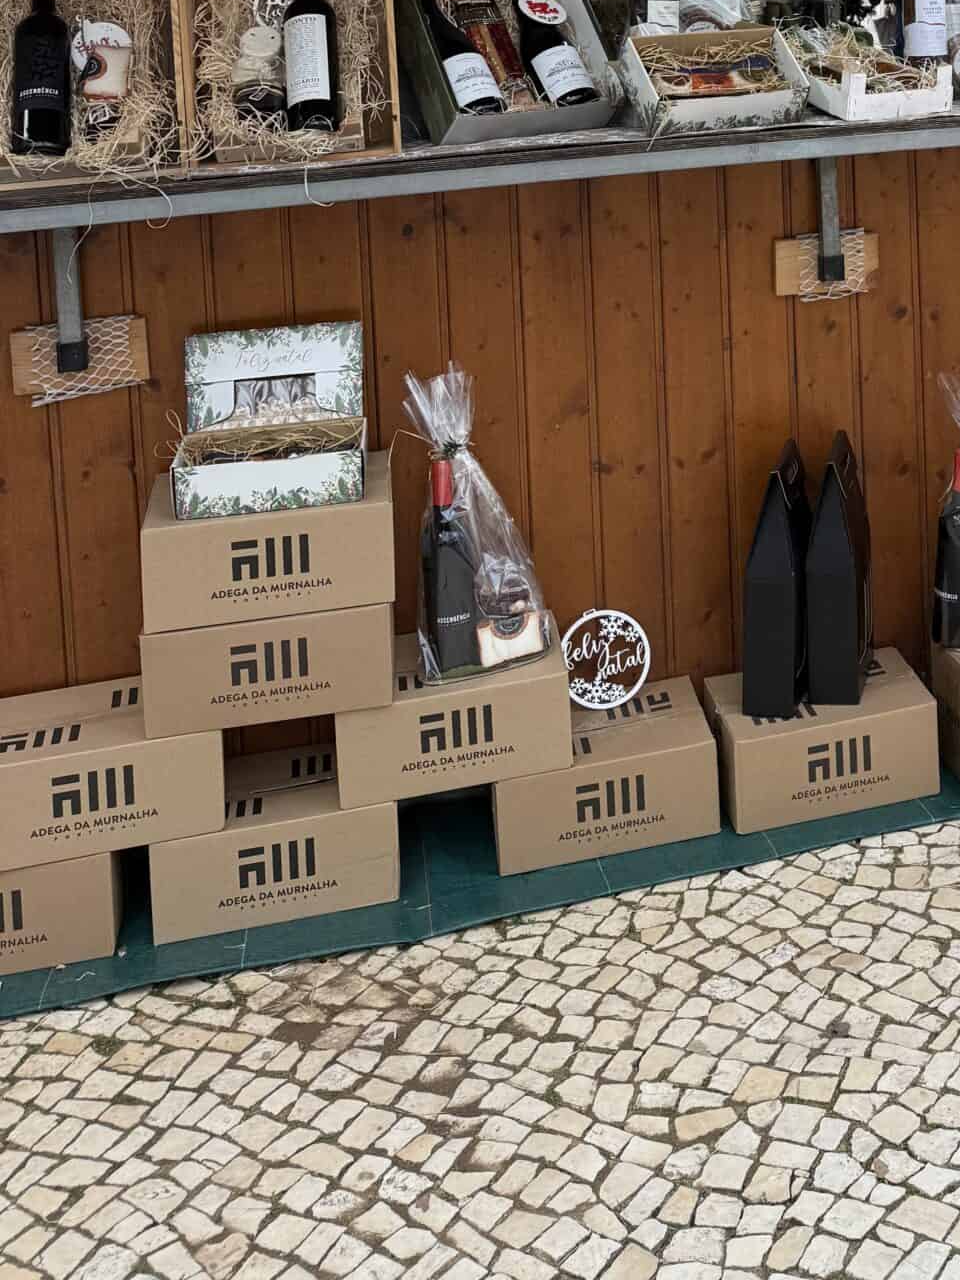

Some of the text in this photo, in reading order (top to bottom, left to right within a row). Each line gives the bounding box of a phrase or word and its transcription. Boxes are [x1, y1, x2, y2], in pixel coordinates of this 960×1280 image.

[210, 587, 249, 600] ADEGA
[252, 586, 268, 595] DA
[210, 692, 249, 705] ADEGA
[251, 690, 267, 699] DA
[401, 760, 438, 773] ADEGA
[439, 756, 455, 766] DA
[791, 788, 822, 801] ADEGA
[824, 785, 838, 794] DA
[30, 823, 72, 839] ADEGA
[74, 820, 90, 831] DA
[558, 828, 593, 842] ADEGA
[594, 824, 609, 834] DA
[218, 894, 257, 909] ADEGA
[258, 891, 274, 901] DA
[0, 933, 48, 950] RNALHA
